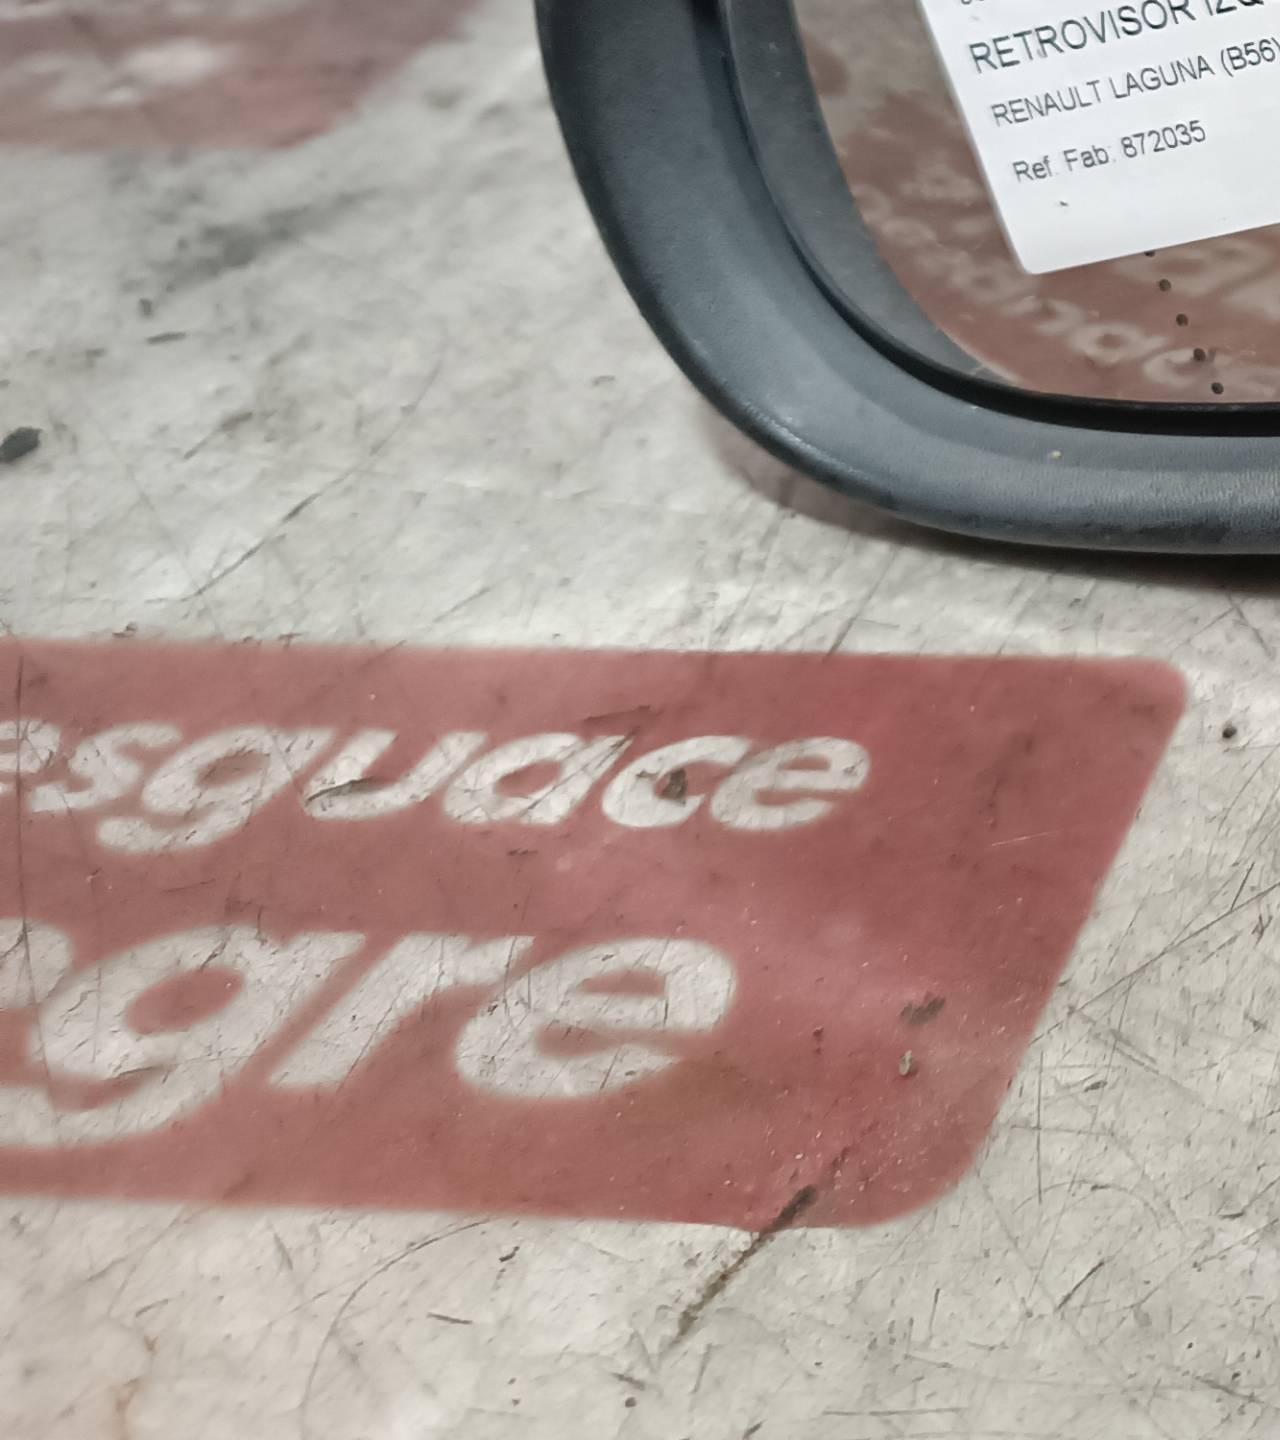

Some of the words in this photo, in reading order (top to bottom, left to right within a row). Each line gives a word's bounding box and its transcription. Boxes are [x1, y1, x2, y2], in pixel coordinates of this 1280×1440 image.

[990, 79, 1103, 127] RENAULT
[1108, 55, 1216, 100] LAGUNA
[1120, 120, 1206, 160] 872035
